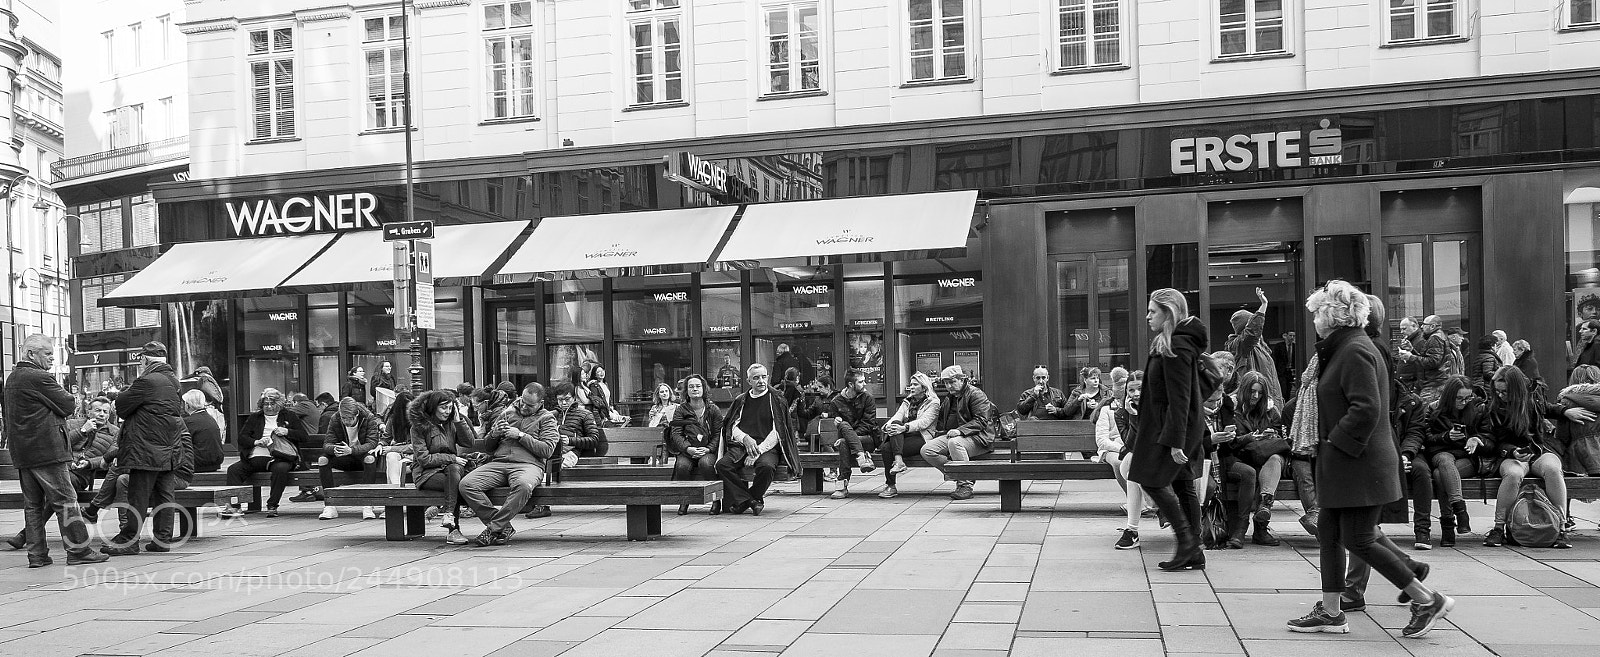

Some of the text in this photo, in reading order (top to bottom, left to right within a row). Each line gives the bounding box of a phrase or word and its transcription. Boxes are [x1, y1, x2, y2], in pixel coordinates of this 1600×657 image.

[1170, 130, 1302, 175] ERSTE
[1309, 155, 1342, 166] BANK
[687, 151, 727, 193] WAGNER
[225, 192, 379, 236] WAGNER
[401, 226, 421, 235] Graben
[816, 236, 874, 245] WAGNER
[585, 250, 638, 259] WAGNER
[937, 277, 975, 288] WAGNER
[792, 285, 828, 295] WAGNER
[653, 292, 687, 302] WAGNER
[269, 312, 298, 321] WAGNER
[643, 327, 667, 335] WAGNER
[262, 344, 283, 352] WAGNER
